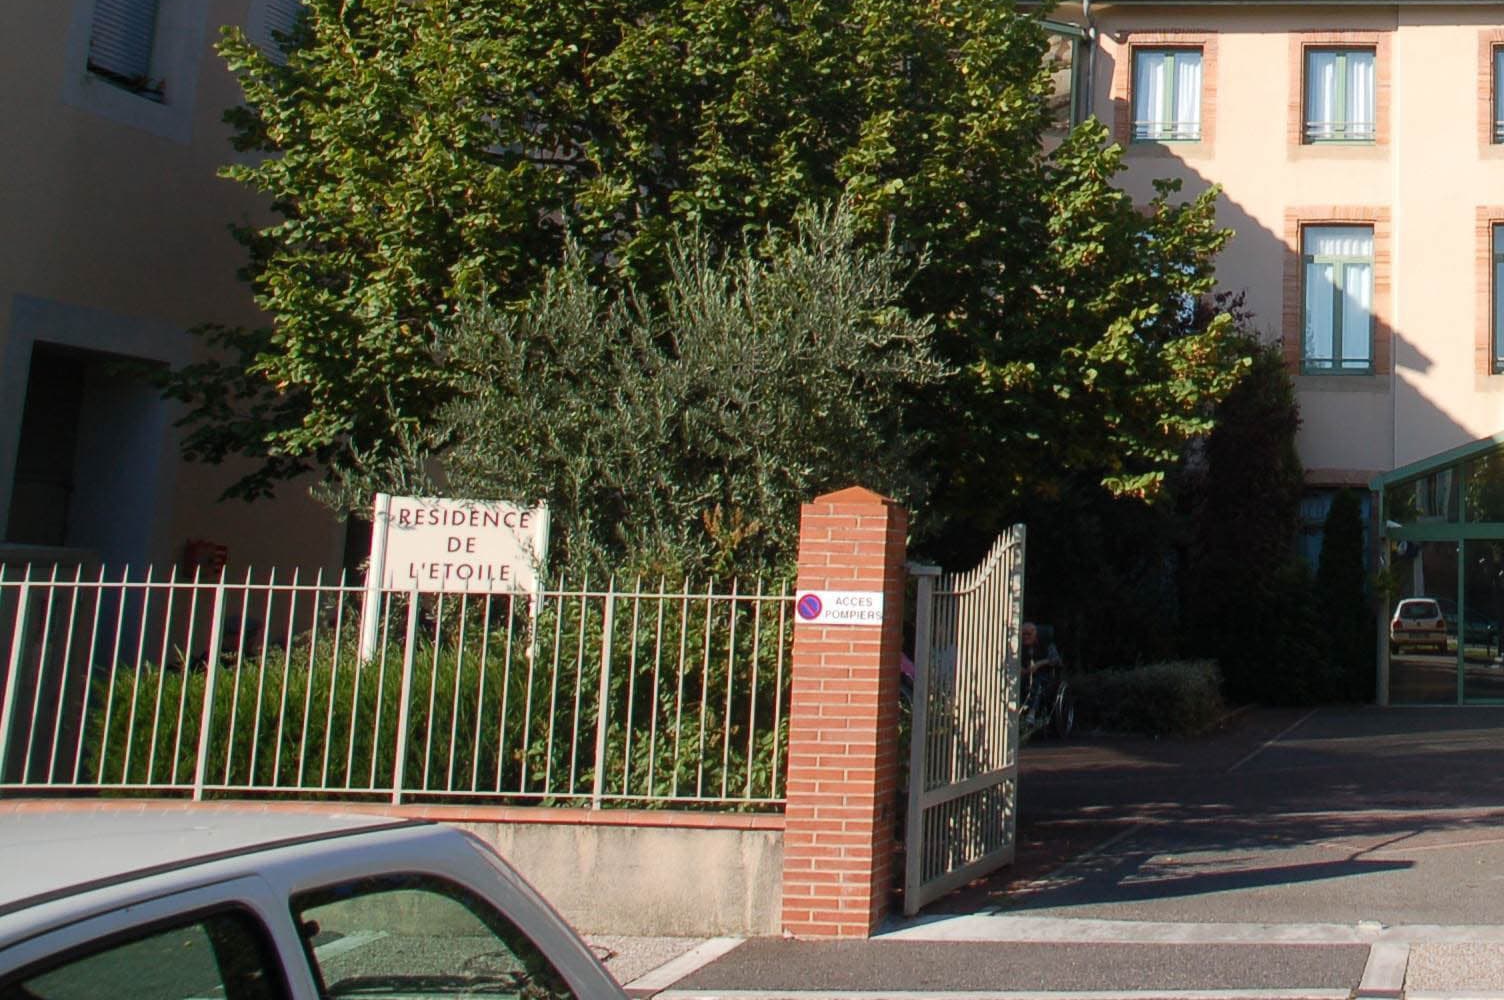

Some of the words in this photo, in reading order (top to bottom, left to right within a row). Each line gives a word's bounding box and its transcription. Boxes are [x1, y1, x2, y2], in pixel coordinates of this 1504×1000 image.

[399, 508, 530, 529] RESIDENCE
[447, 536, 476, 553] DE
[409, 562, 510, 581] L'ETOILE
[835, 597, 873, 607] ACCES
[825, 609, 882, 620] POMPIERS
